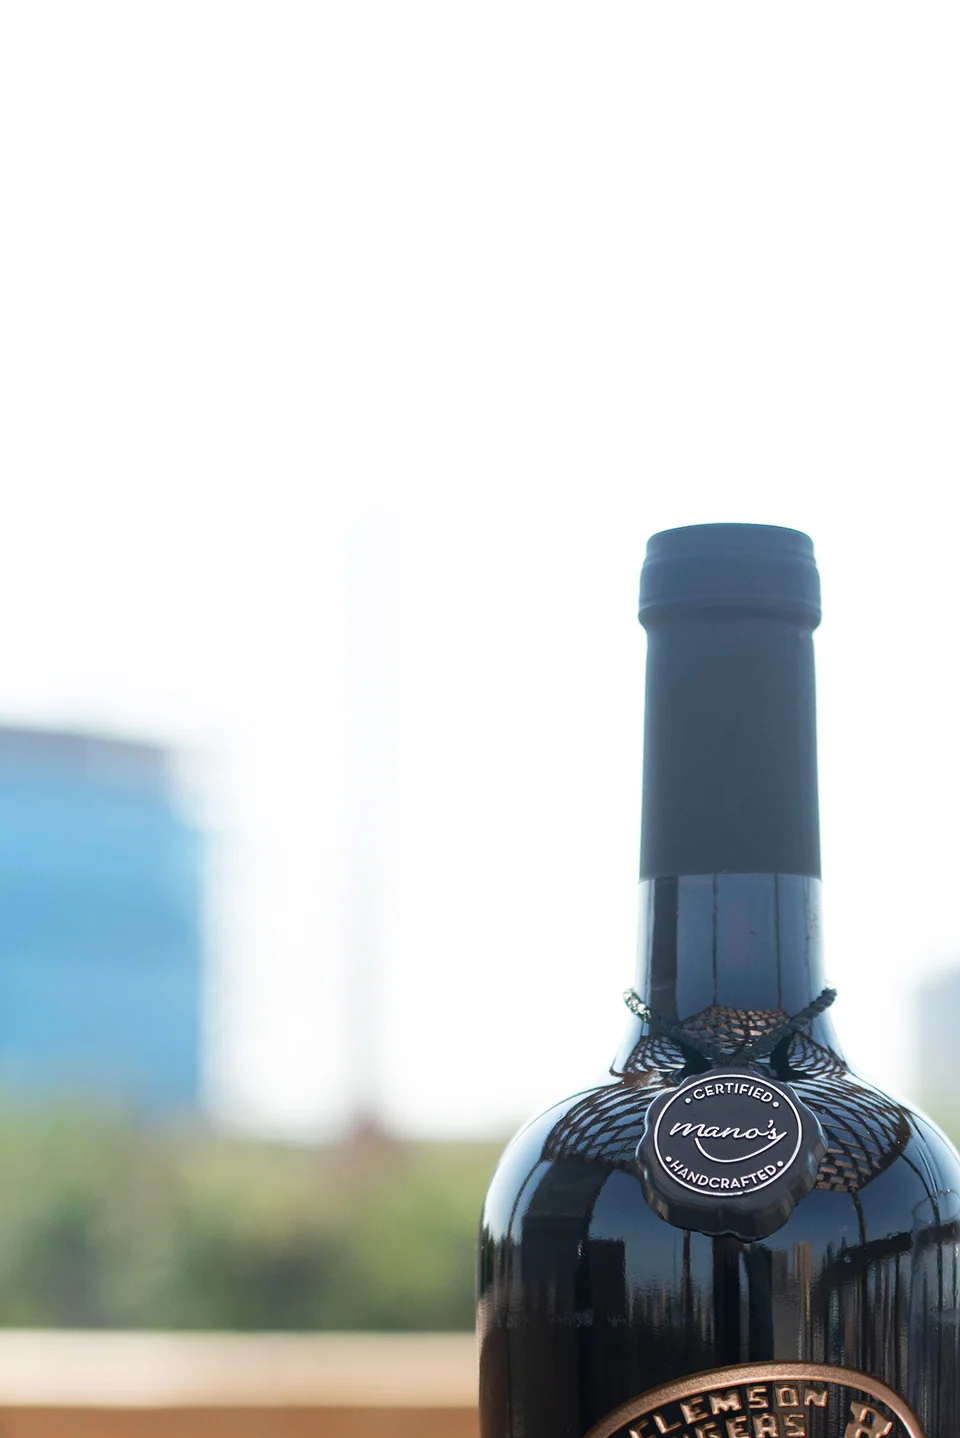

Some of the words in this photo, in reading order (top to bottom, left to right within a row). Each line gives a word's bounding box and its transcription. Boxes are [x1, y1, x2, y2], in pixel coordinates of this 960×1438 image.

[692, 1082, 774, 1104] CERTIFIED
[668, 1119, 788, 1144] mano's
[669, 1159, 777, 1189] HANDCRAFTED
